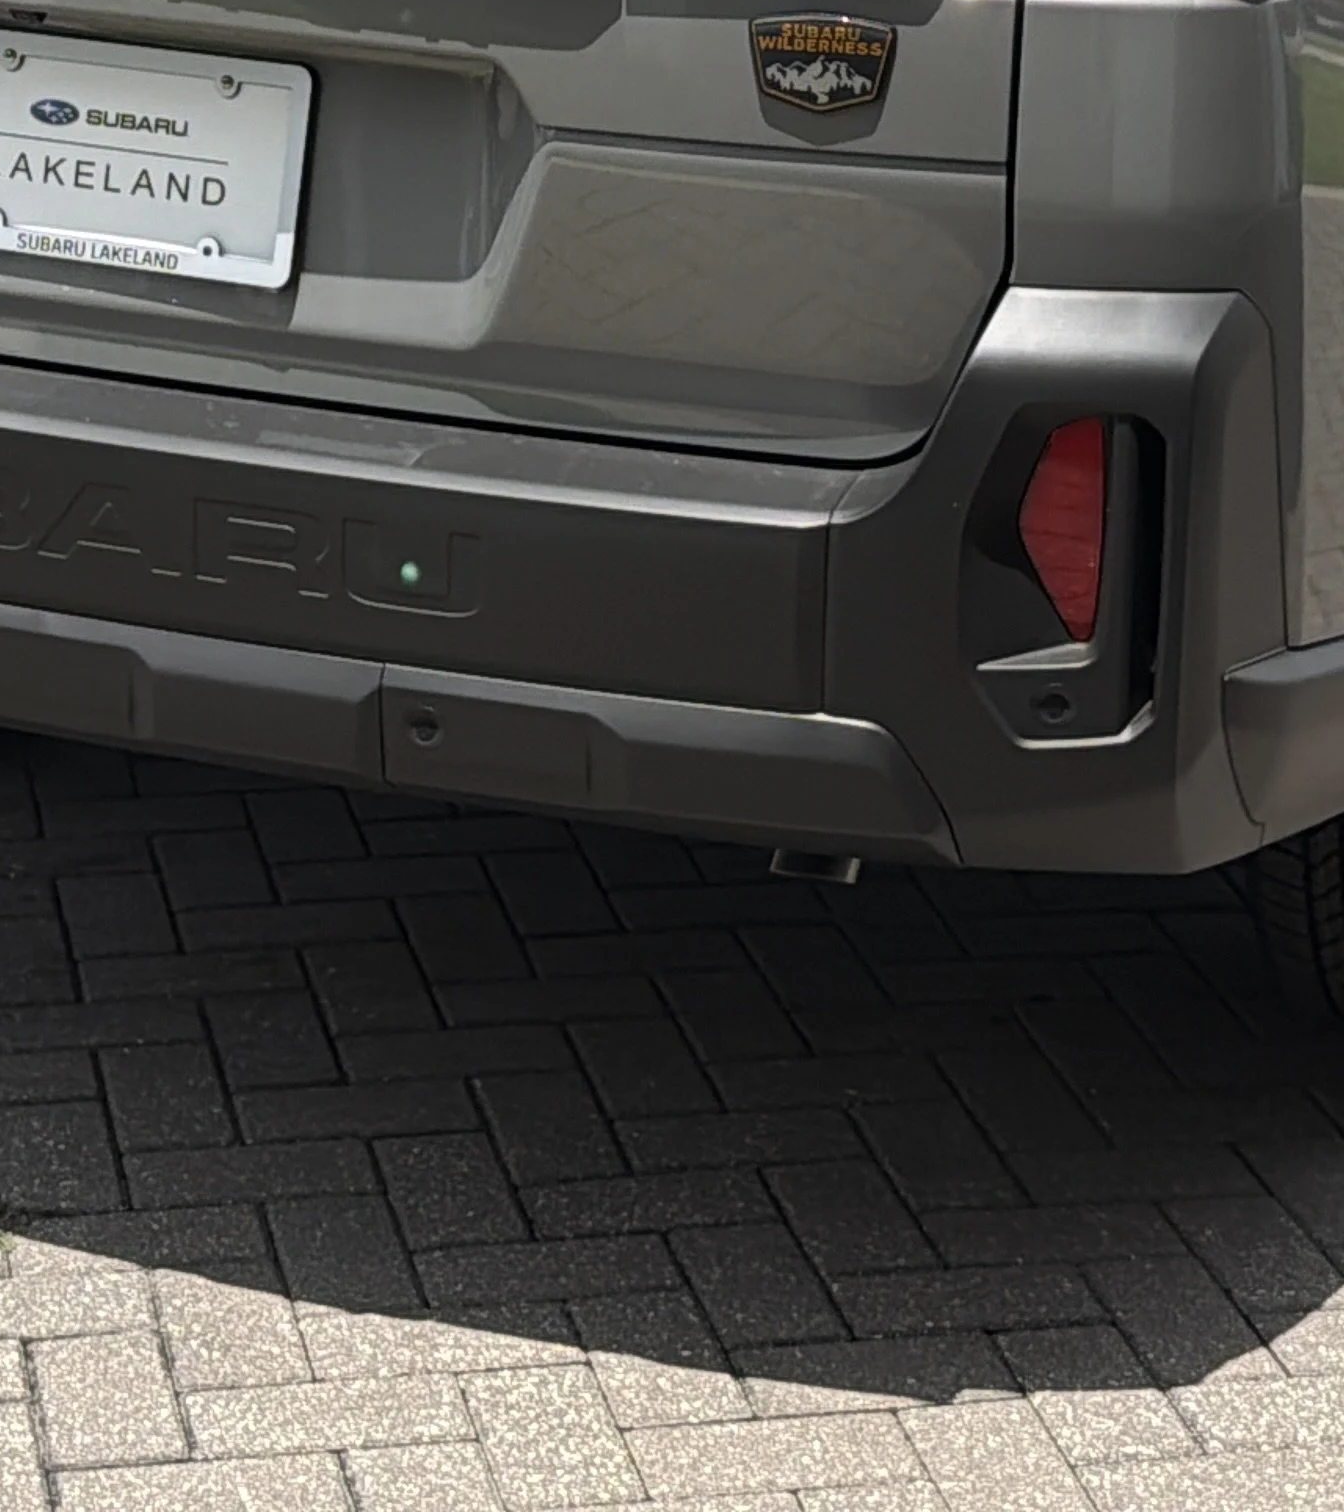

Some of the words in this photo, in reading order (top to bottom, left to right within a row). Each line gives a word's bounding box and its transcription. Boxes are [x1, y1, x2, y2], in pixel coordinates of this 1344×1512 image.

[781, 22, 862, 42] SUBARU
[758, 35, 884, 57] WILDERNESS
[85, 108, 189, 138] SUBARU
[15, 232, 87, 259] SUBARU
[90, 241, 180, 271] LAKELAND
